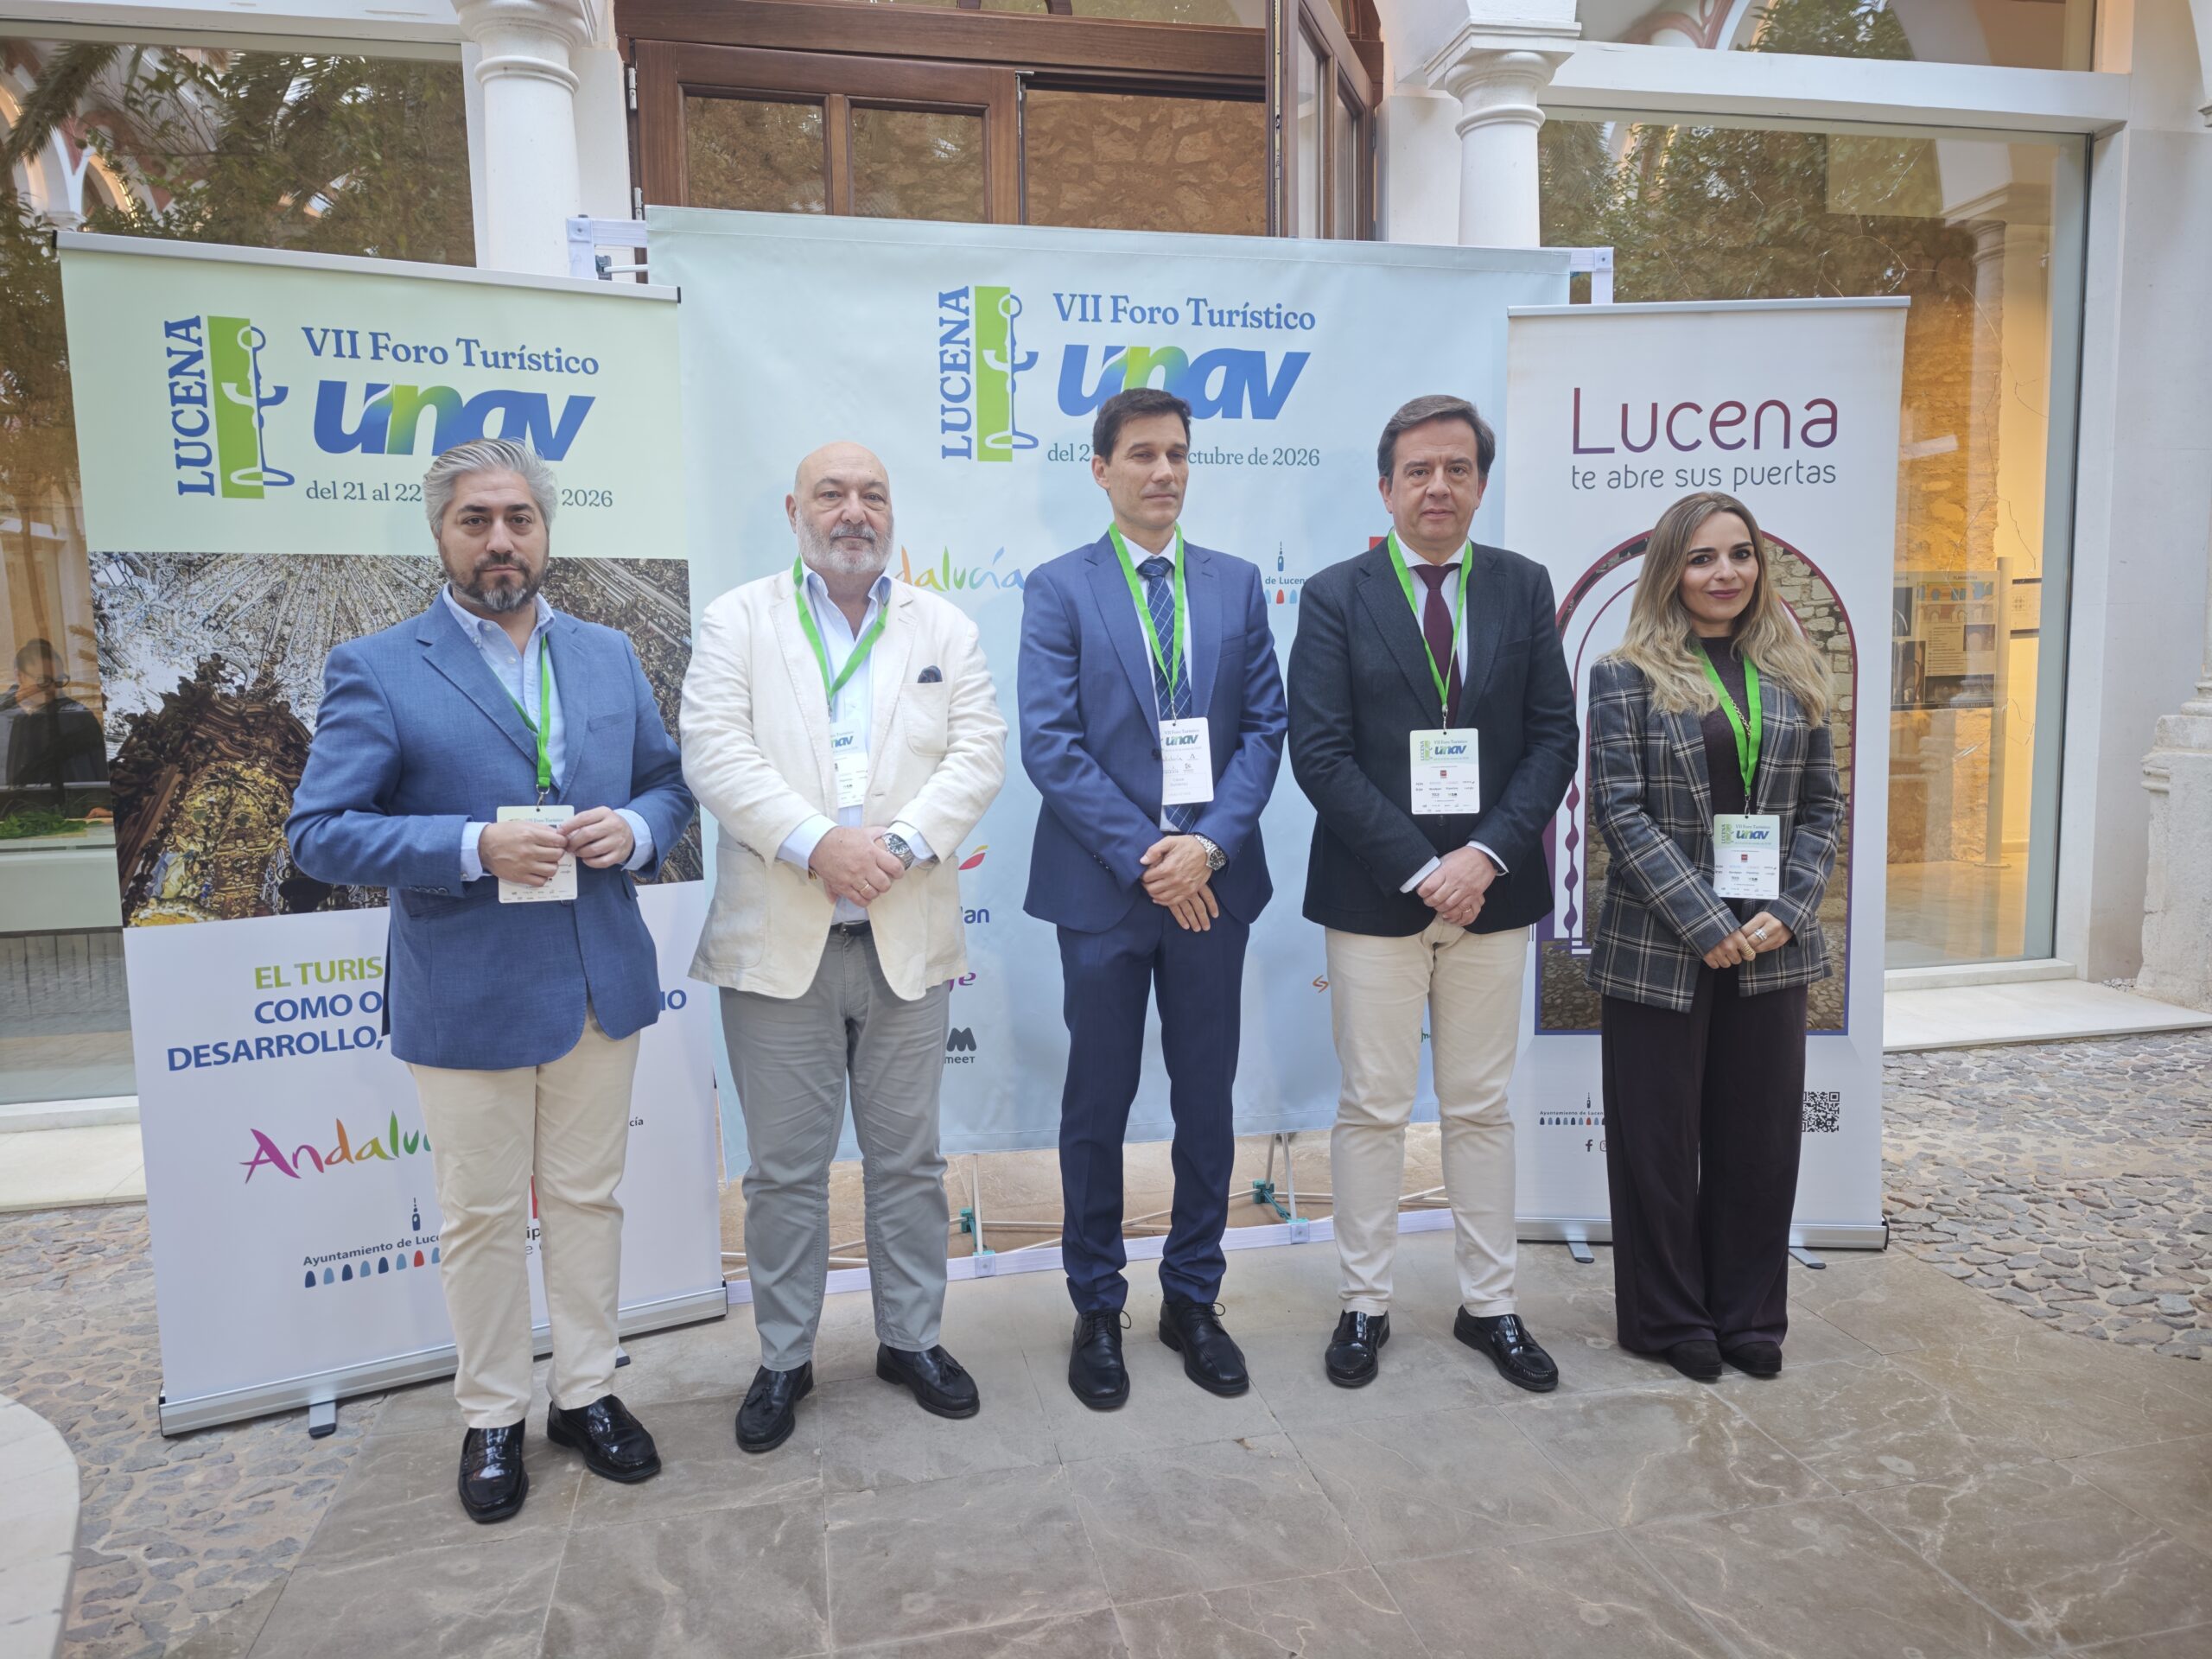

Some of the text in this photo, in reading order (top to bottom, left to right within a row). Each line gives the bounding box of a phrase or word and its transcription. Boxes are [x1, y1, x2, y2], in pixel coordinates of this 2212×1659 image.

[1052, 293, 1316, 331] VII Foro Turístico
[301, 327, 600, 375] VII Foro Turístico
[938, 286, 973, 460] LUCENA
[1058, 344, 1312, 420] unav
[164, 315, 215, 497] LUCENA
[314, 379, 596, 461] unav
[1572, 387, 1838, 455] Lucena
[1047, 442, 1074, 461] del
[1187, 446, 1243, 465] ctubre
[1248, 447, 1268, 465] de
[1272, 448, 1320, 467] 2026
[306, 480, 613, 508] del 21 al 22 2026
[1572, 460, 1837, 493] te abre sus puertas
[895, 544, 1025, 593] dalucía
[1279, 576, 1307, 585] Lucen
[830, 735, 854, 748] nav
[1434, 745, 1467, 755] unav
[1736, 830, 1770, 840] unav
[254, 956, 385, 989] EL TURIS
[254, 994, 353, 1024] COMO
[167, 1026, 384, 1071] DESARROLLO,
[238, 1109, 432, 1185] Andalu
[303, 1234, 440, 1267] Ayuntamiento de Luc
